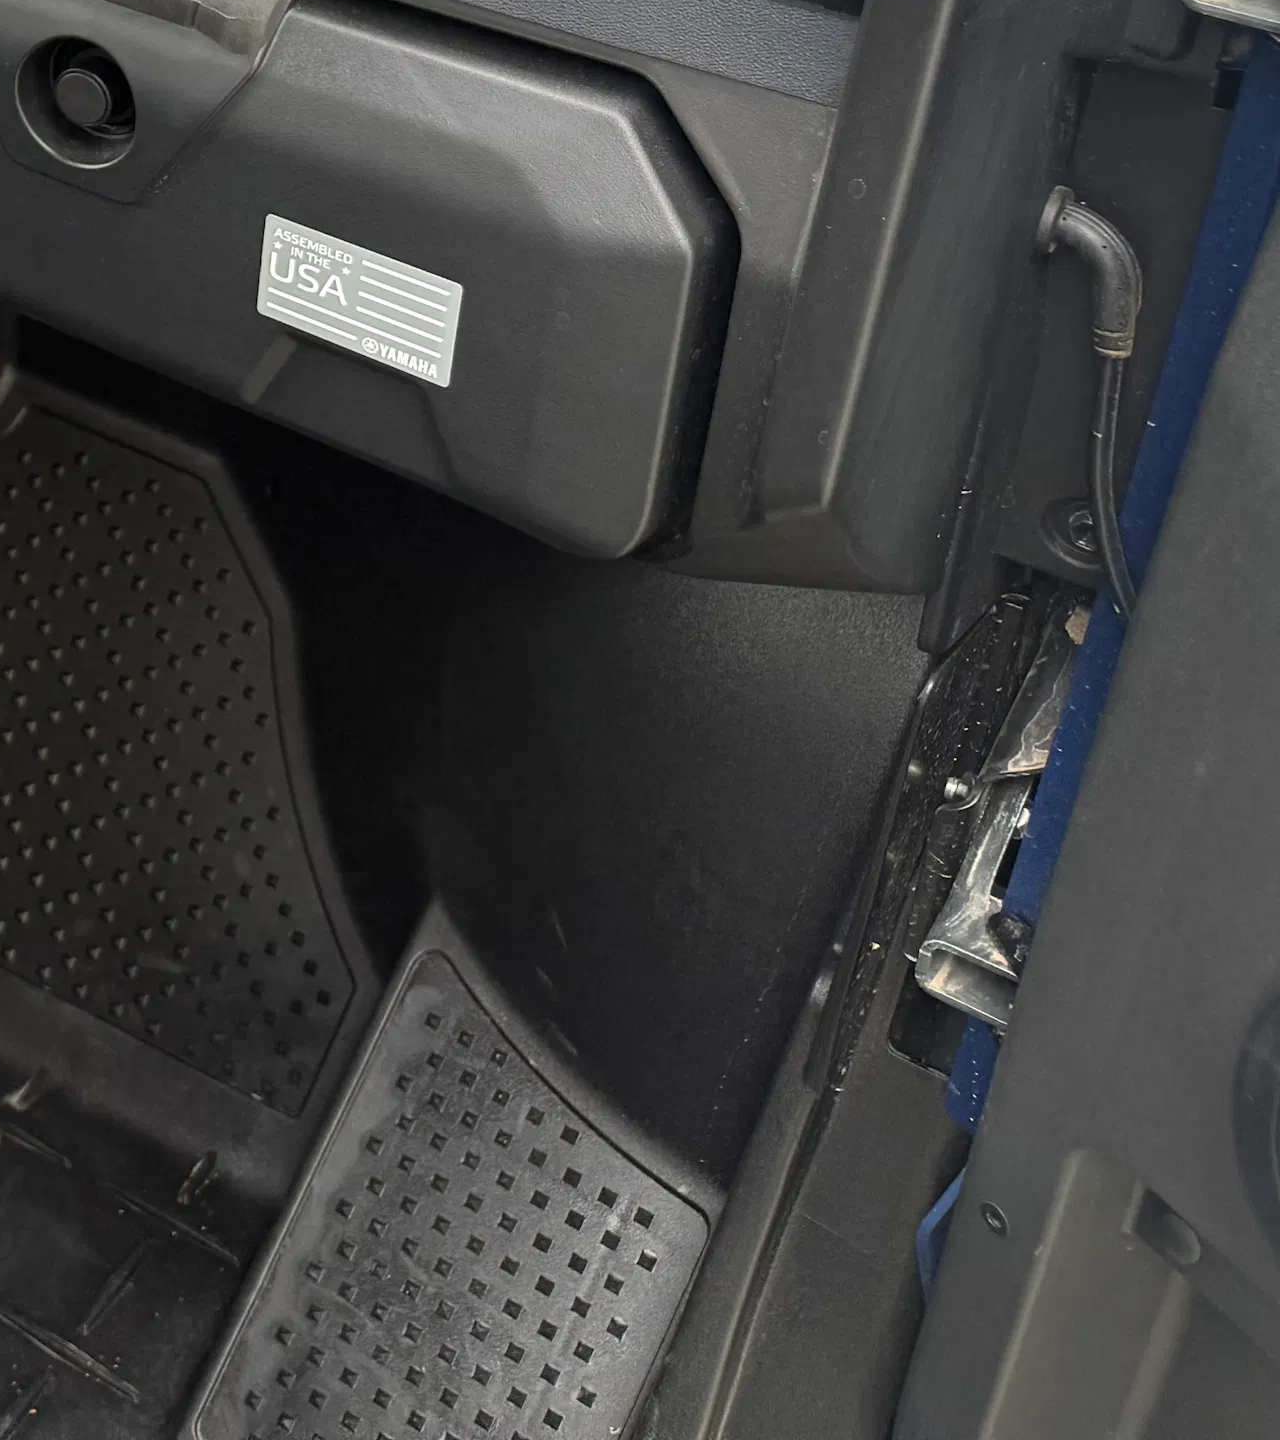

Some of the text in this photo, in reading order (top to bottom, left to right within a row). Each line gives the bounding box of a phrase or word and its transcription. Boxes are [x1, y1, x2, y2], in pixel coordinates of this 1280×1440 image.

[274, 228, 353, 265] ASSEMBLED
[291, 246, 331, 270] IN THE
[269, 251, 348, 307] USA
[380, 343, 438, 379] YAMAHA
